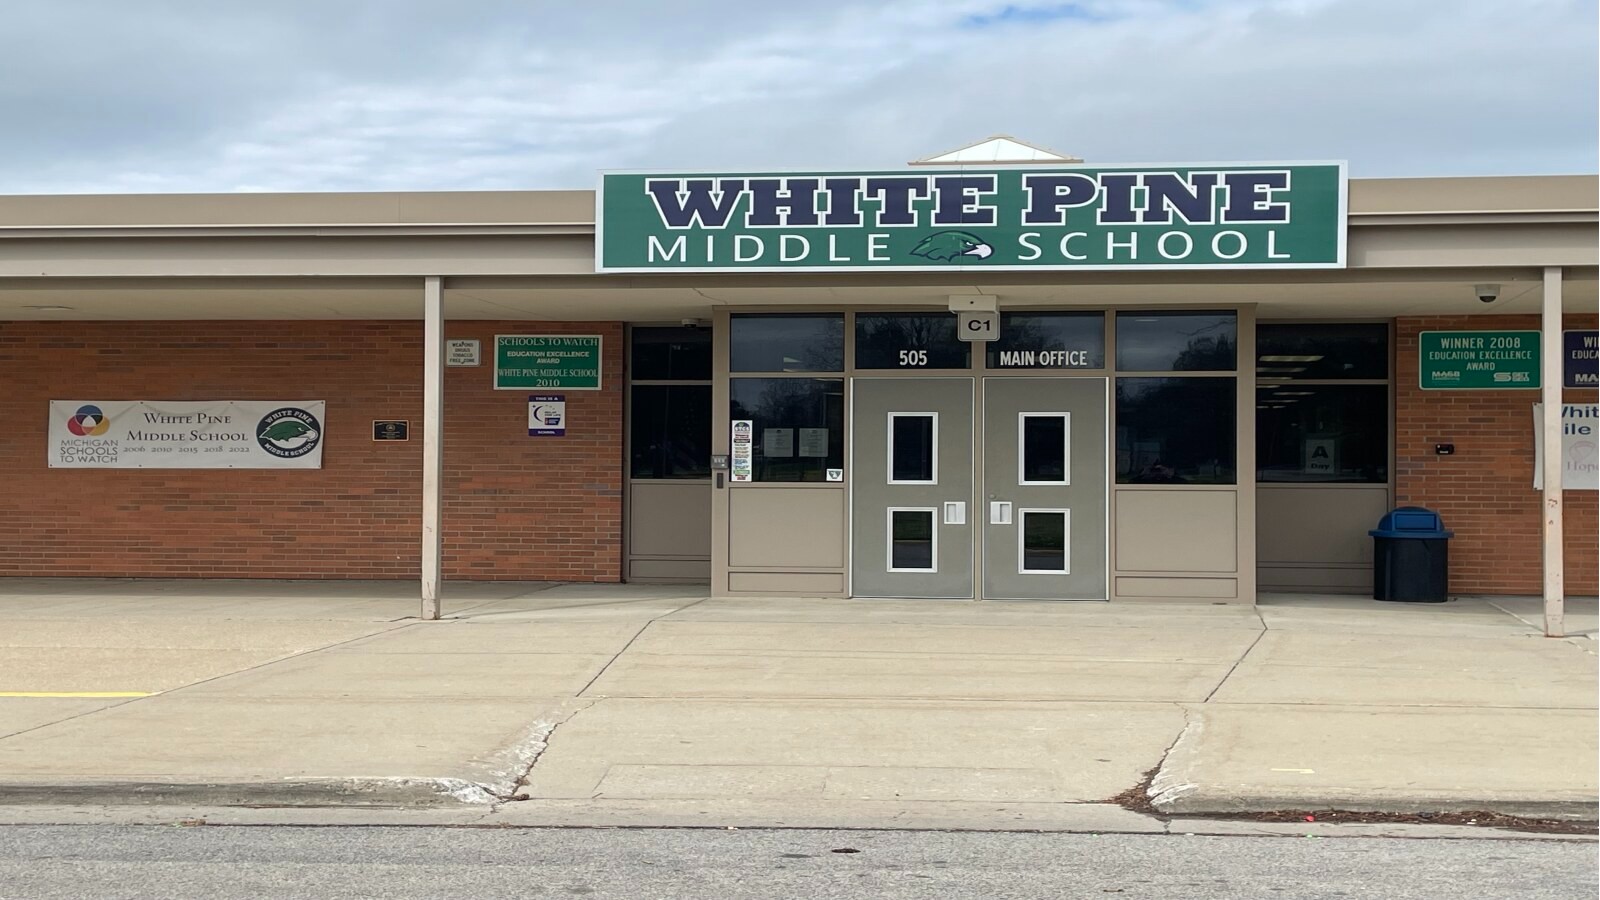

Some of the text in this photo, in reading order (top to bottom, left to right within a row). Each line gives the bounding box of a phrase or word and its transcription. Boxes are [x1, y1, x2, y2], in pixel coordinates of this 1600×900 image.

[645, 170, 1291, 229] WHITE PINE
[648, 230, 1291, 262] MIDDLE SCHOOL
[968, 320, 991, 331] C1
[1440, 337, 1521, 349] WINNER 2008
[900, 350, 928, 366] 505
[1000, 350, 1088, 366] MAIN OFFICE
[1429, 350, 1532, 360] EDUCATION EXCELLENCE
[1466, 362, 1496, 370] AWARD
[144, 412, 232, 424] WHITE PINE
[264, 410, 313, 424] WHITE PINE
[126, 430, 248, 441] MIDDLE SCHOOL
[60, 446, 118, 456] SCHOOLS
[264, 442, 314, 456] MIDDLE SCHOOL
[1312, 446, 1328, 458] A
